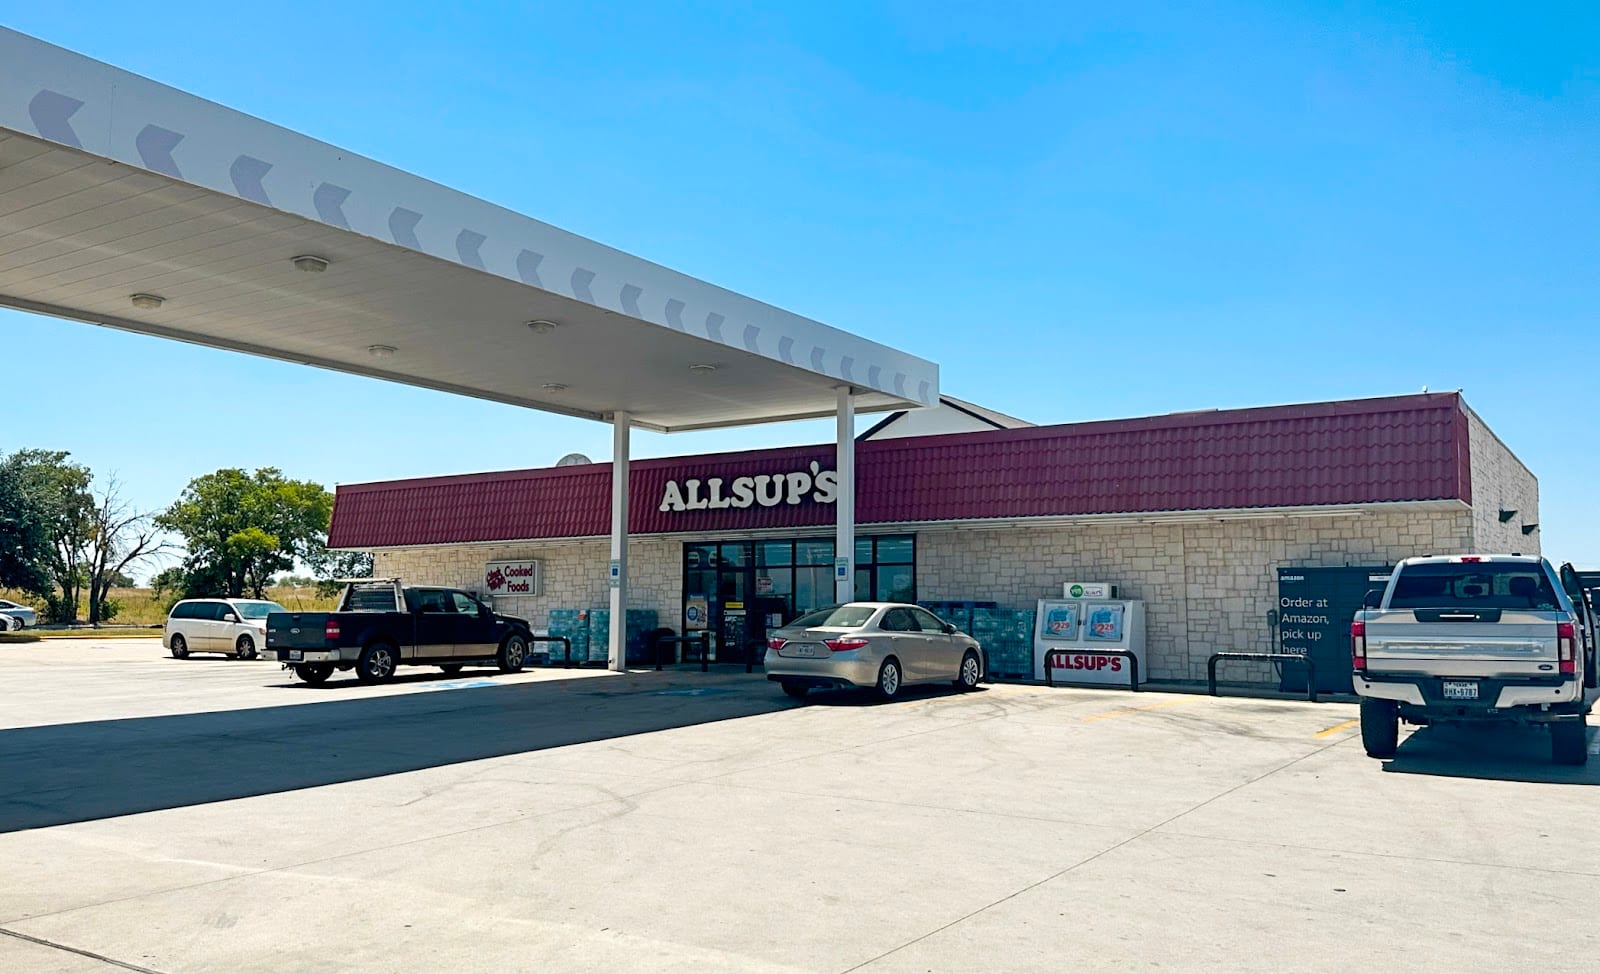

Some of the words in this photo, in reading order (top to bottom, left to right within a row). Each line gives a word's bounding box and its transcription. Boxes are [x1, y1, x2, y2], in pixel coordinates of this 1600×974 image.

[659, 461, 837, 511] ALLSUP'S
[504, 564, 533, 577] Cooked
[507, 579, 529, 592] Foods
[1280, 597, 1313, 608] Order
[1316, 598, 1329, 608] at
[1281, 613, 1330, 625] Amazon,
[1282, 629, 1304, 640] pick
[1307, 631, 1322, 641] up
[1282, 644, 1307, 655] here
